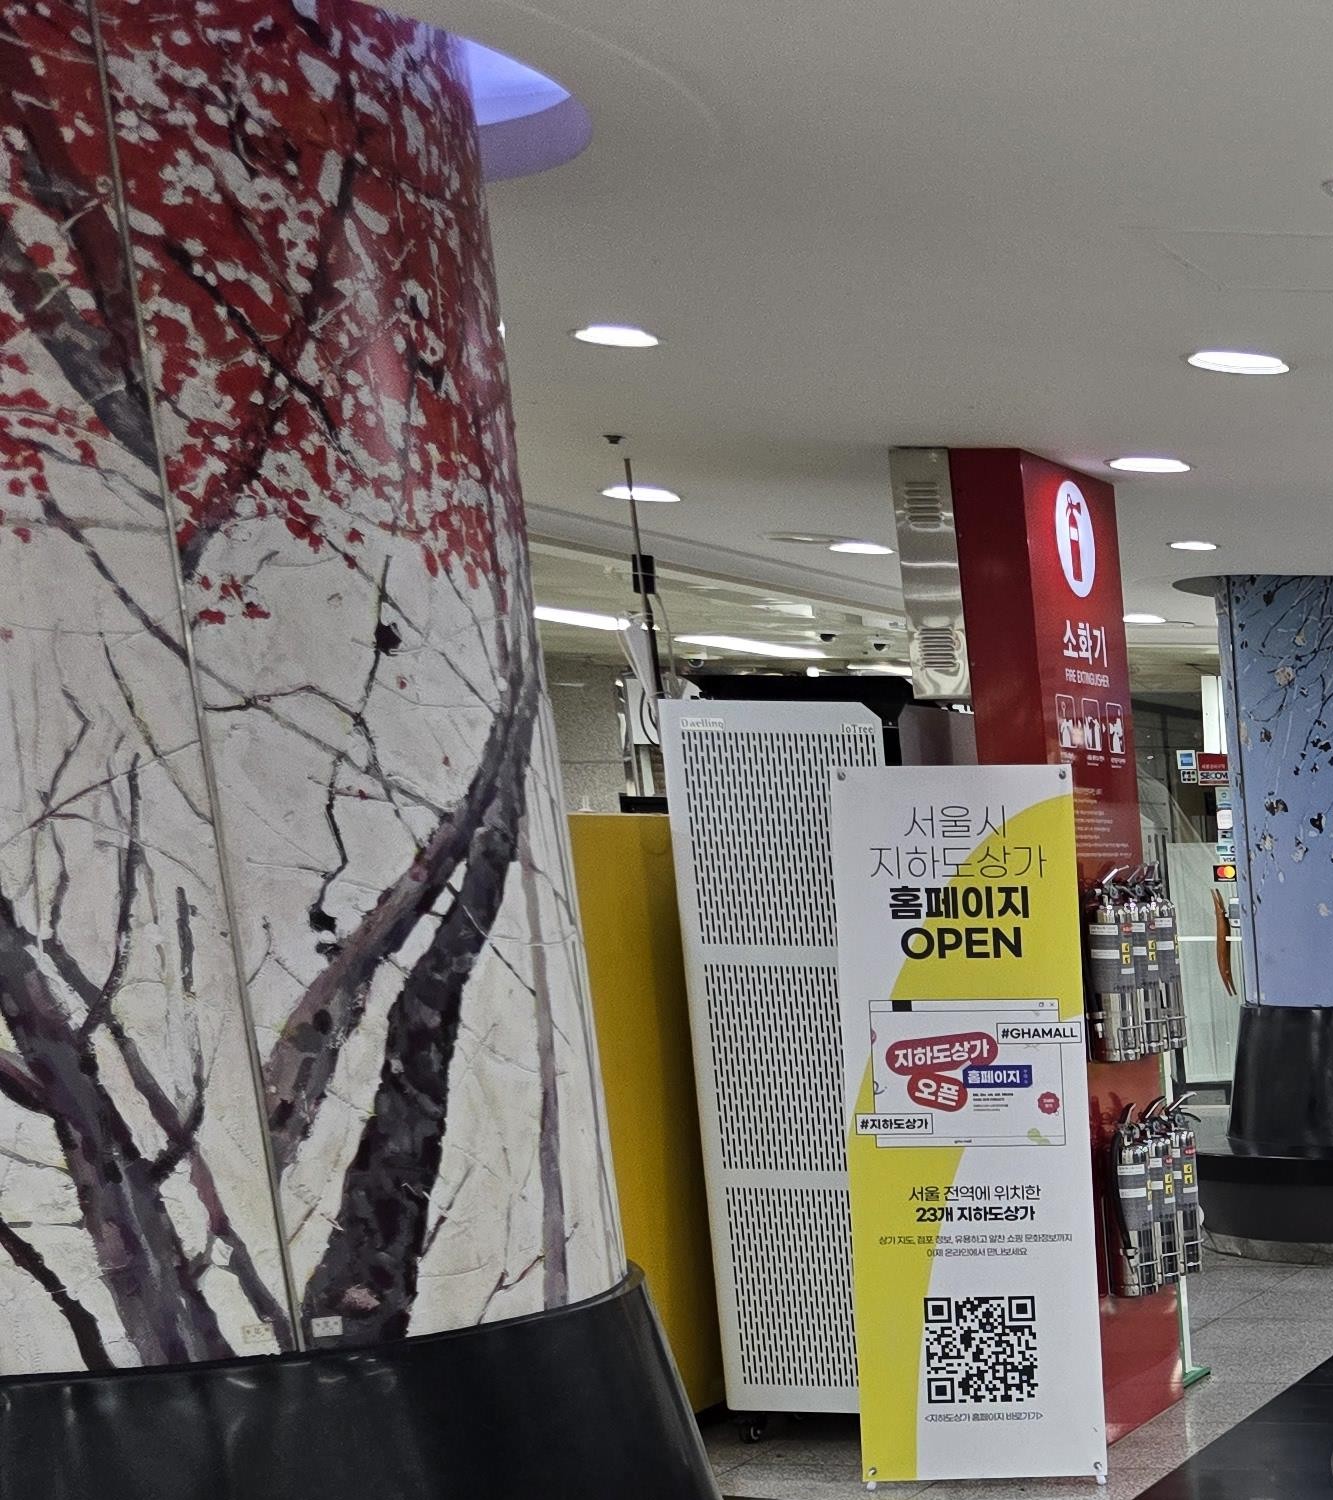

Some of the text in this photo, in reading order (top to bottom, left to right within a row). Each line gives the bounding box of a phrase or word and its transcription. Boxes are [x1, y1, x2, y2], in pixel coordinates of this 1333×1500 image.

[1063, 619, 1108, 668] 소화기
[1065, 668, 1077, 683] FIRE
[841, 723, 874, 734] IoTree
[1200, 771, 1229, 780] SECOM
[904, 804, 1007, 839] 서울시
[869, 844, 1048, 880] 지하도상가
[888, 885, 1030, 920] 홈페이지
[900, 926, 1023, 960] OPEN
[1001, 1027, 1079, 1040] #GHAMALL
[894, 1038, 990, 1069] 지하도상가
[967, 1069, 1021, 1084] 홈페이지
[914, 1077, 961, 1108] 오픈
[859, 1118, 929, 1131] #지하도상가
[908, 1184, 1042, 1202] 서울 전역에 위치한
[915, 1205, 1036, 1223] 23개 지하도상가
[1006, 1234, 1024, 1244] 쇼핑
[944, 1248, 986, 1257] 온라인에서
[972, 1412, 1005, 1422] 홈페이지
